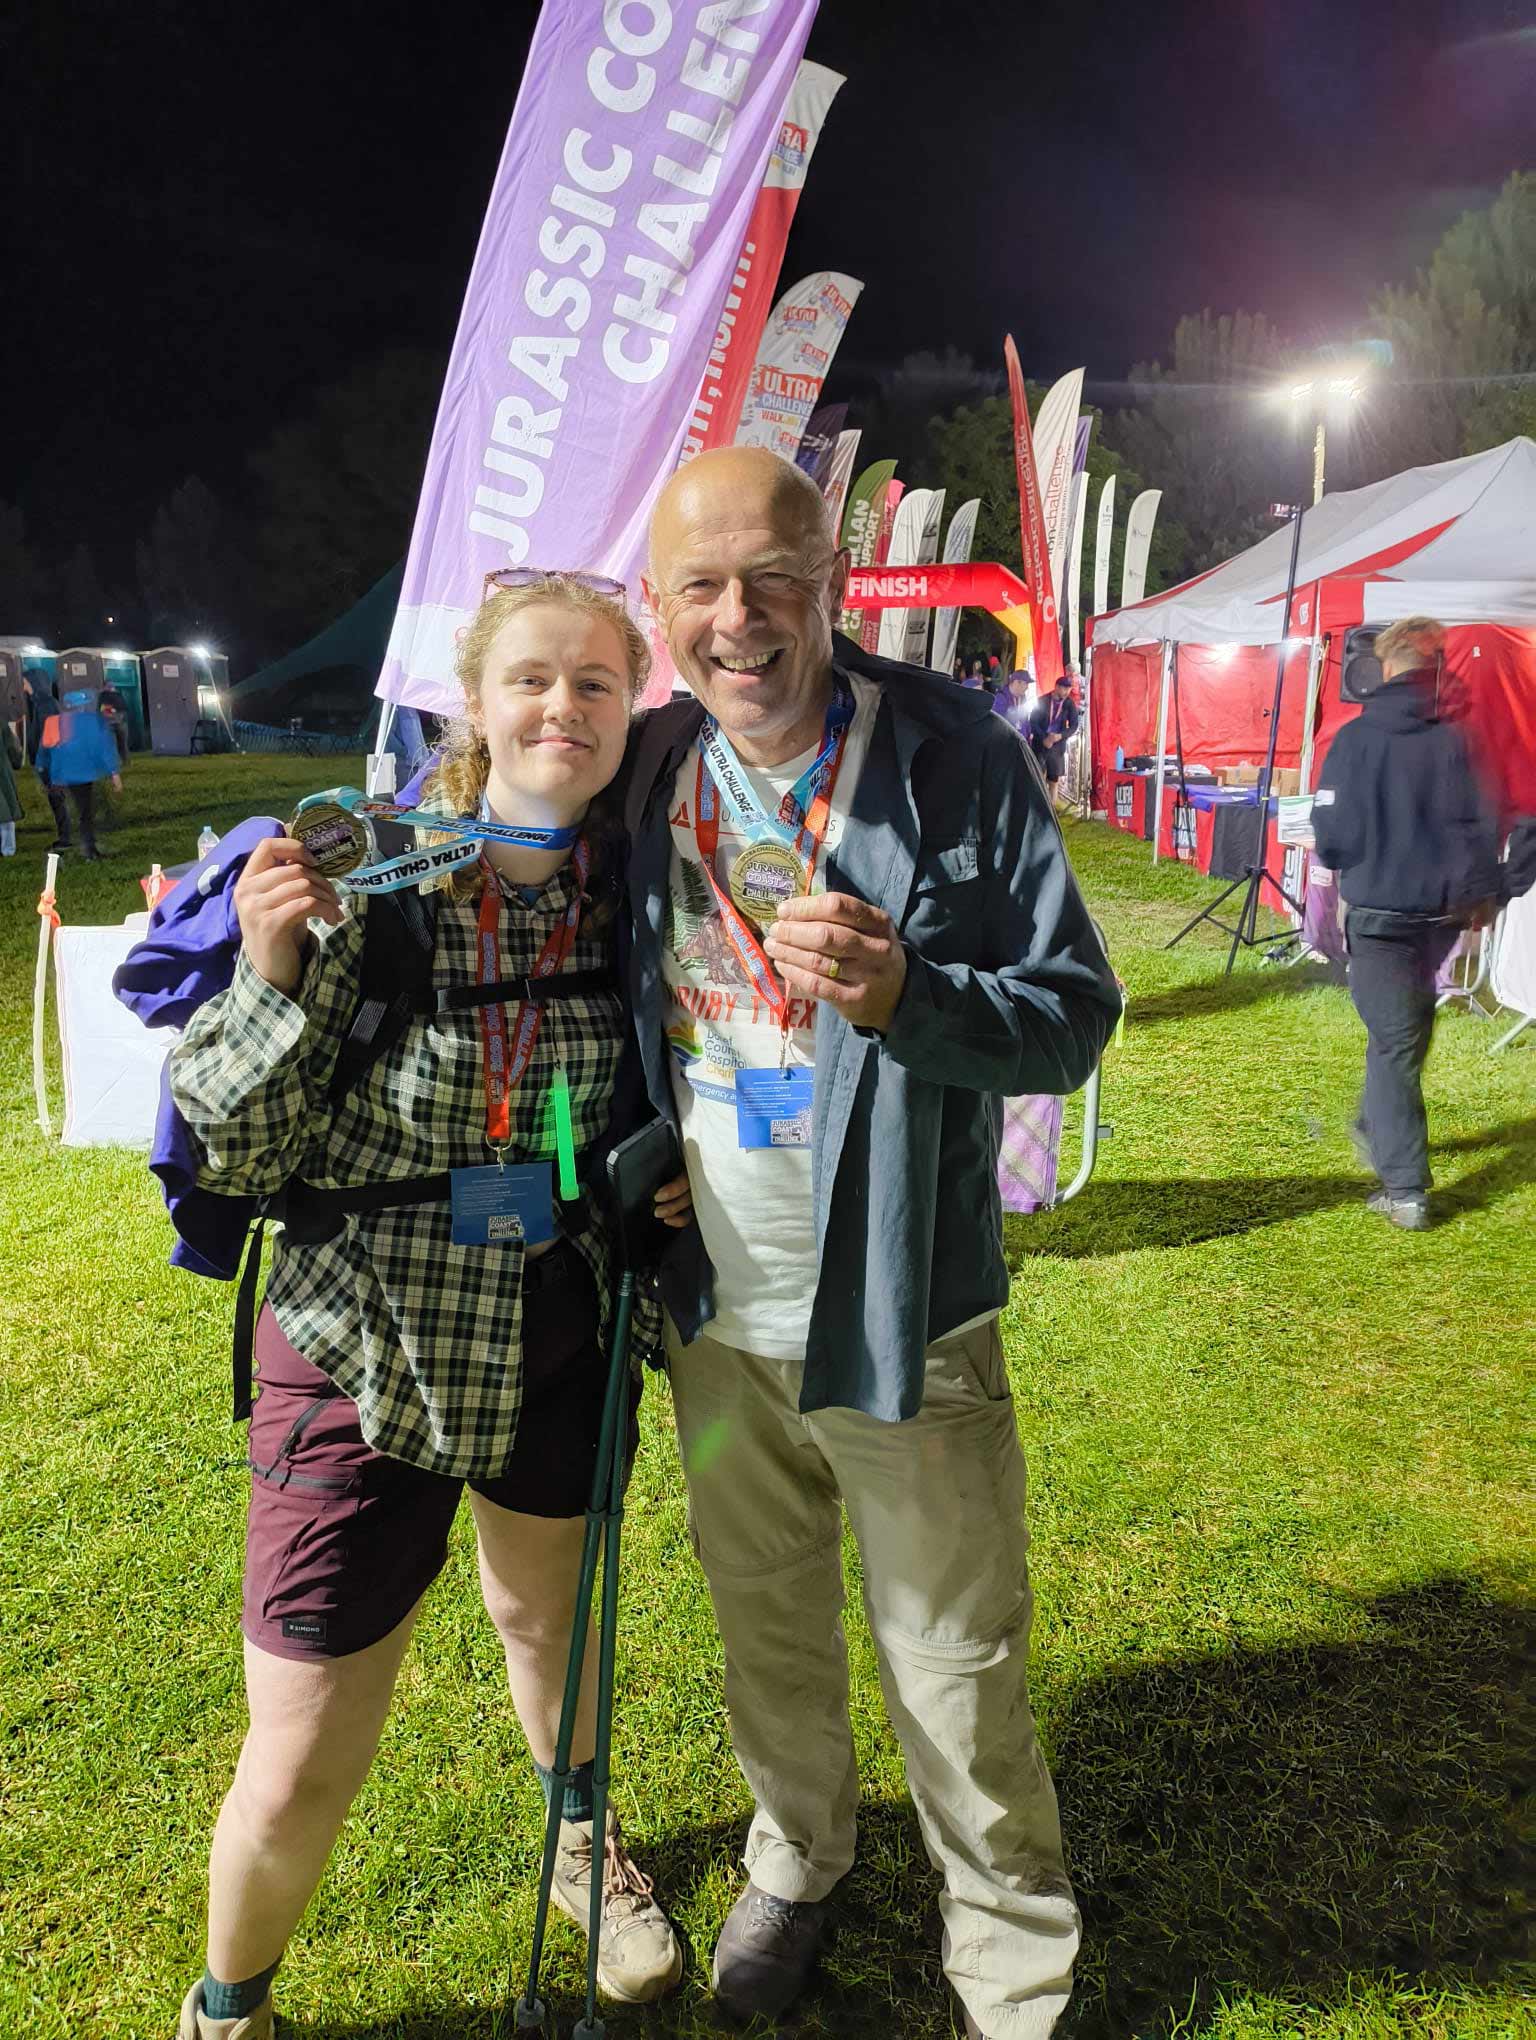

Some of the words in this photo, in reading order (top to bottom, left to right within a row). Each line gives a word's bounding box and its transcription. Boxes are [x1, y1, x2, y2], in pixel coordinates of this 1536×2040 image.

[468, 127, 633, 564] JURASSIC
[764, 371, 819, 402] ULTRA
[848, 577, 928, 597] FINISH
[709, 744, 728, 772] ULTRA
[722, 769, 754, 816] CHALLENGE
[306, 831, 338, 849] COAST
[474, 826, 553, 842] CHALLENGE
[431, 843, 476, 865] ULTRA
[344, 858, 430, 888] CHALLENGE
[747, 861, 796, 878] JURASSIC
[747, 871, 782, 886] COAST
